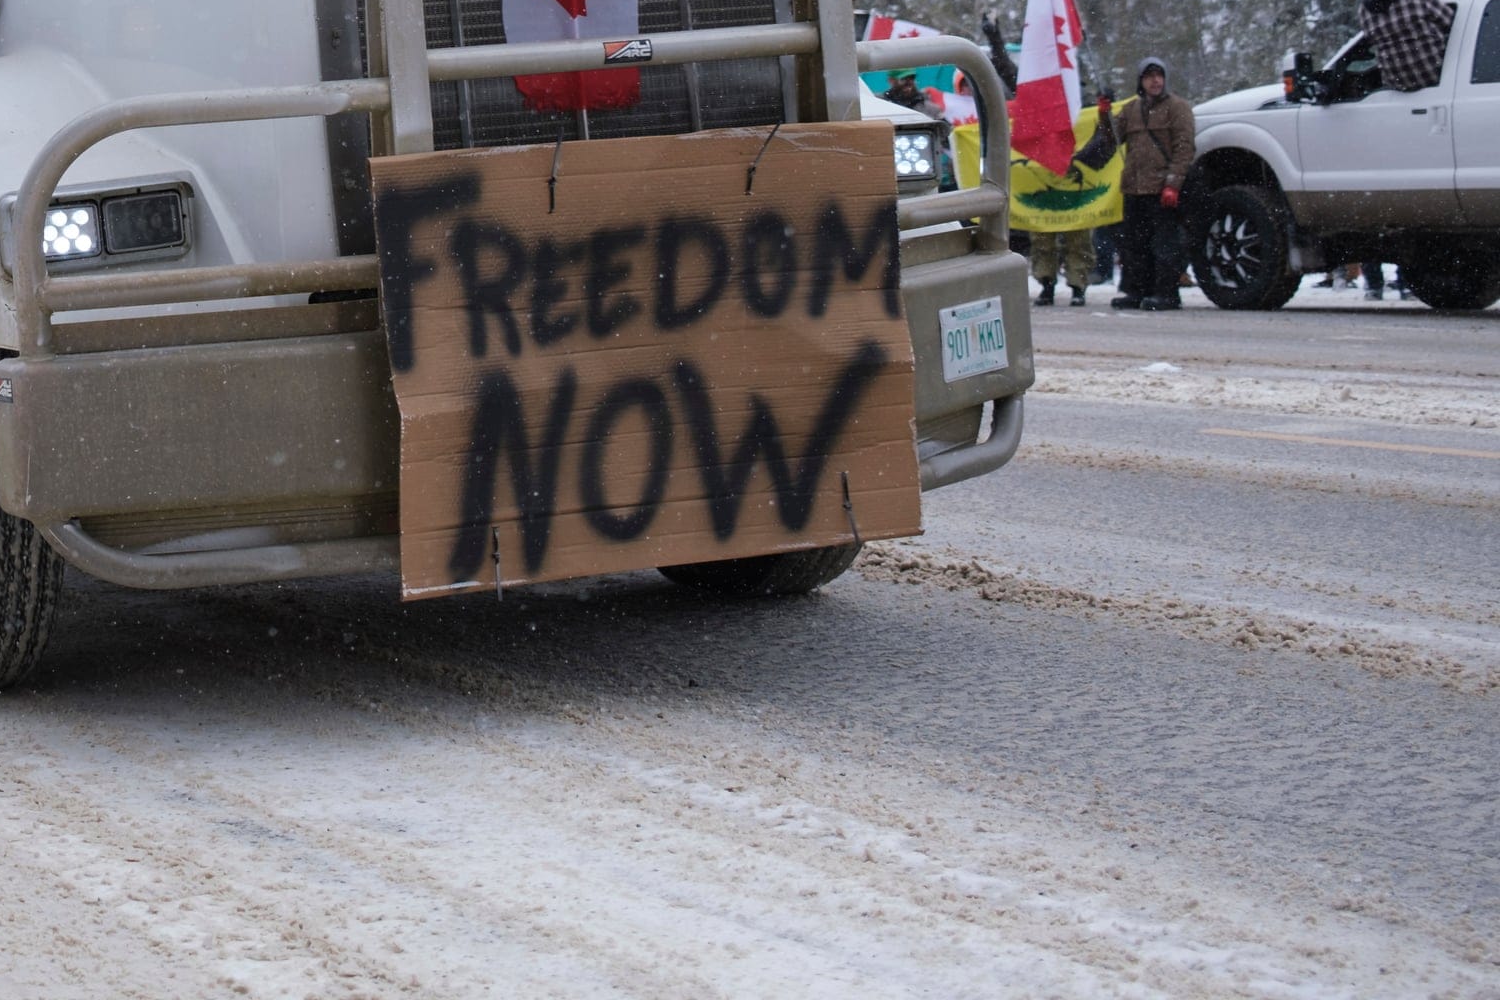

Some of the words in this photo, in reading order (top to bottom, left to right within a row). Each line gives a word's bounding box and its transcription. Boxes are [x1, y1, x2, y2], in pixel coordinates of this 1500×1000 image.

[376, 170, 901, 373] FREEDOM
[947, 326, 970, 362] 901
[977, 318, 1004, 355] KKD
[448, 339, 888, 580] NOW
